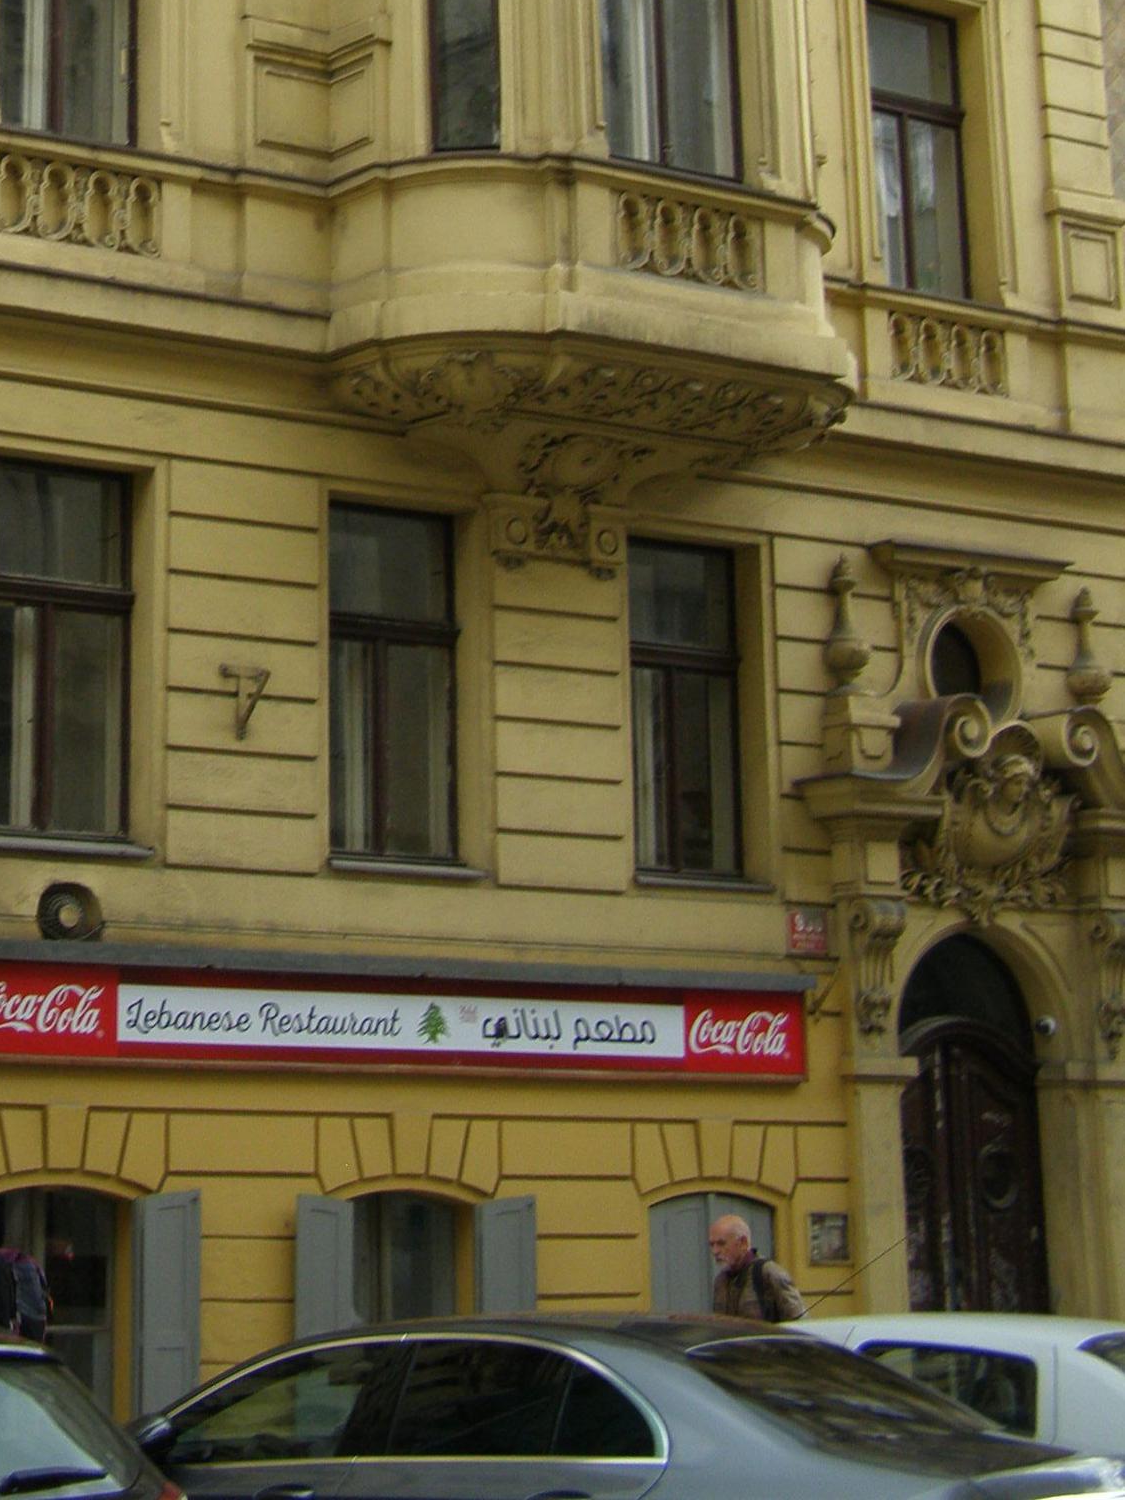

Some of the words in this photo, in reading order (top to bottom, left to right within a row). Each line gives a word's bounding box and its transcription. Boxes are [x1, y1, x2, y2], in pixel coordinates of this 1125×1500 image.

[126, 997, 252, 1035] Lebanese
[259, 1001, 403, 1038] Restaurant
[481, 1007, 562, 1050] لبناني
[574, 1014, 656, 1051] مطعم
[689, 1008, 789, 1056] Coca-Cola
